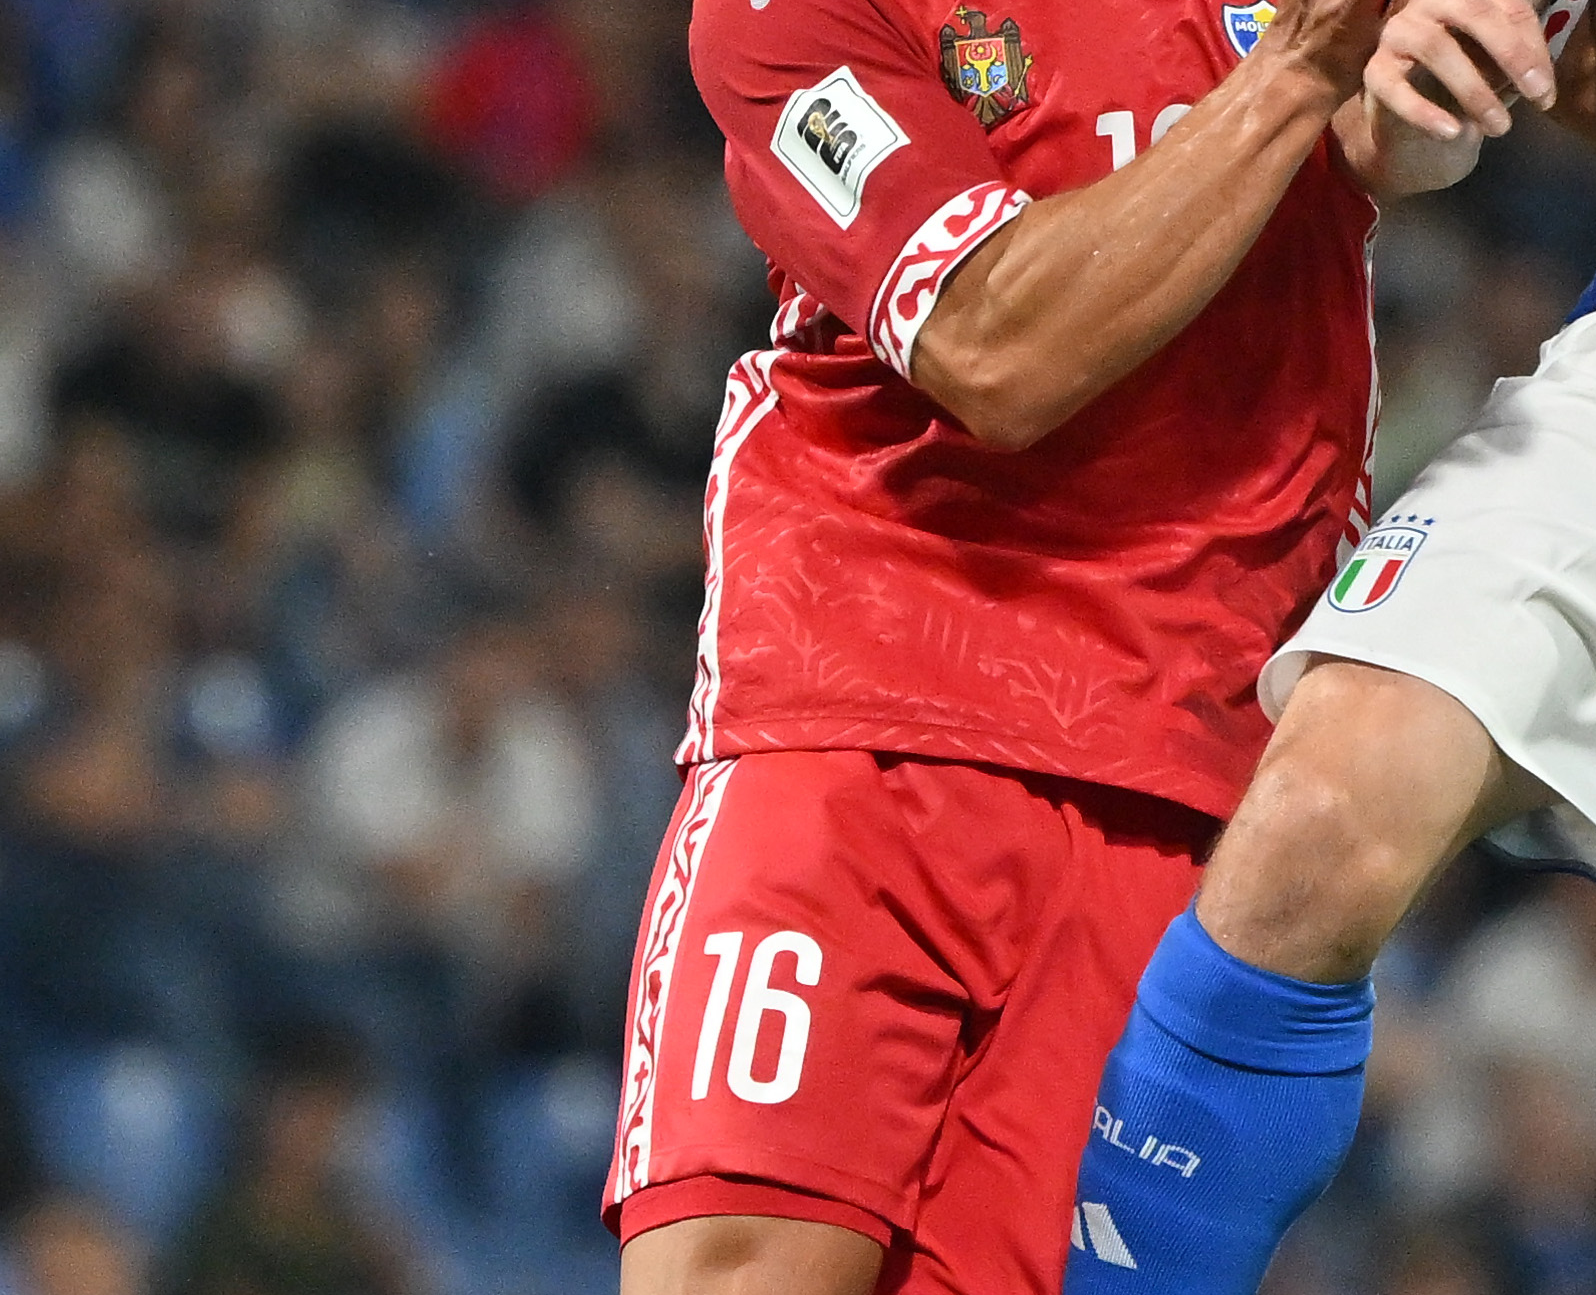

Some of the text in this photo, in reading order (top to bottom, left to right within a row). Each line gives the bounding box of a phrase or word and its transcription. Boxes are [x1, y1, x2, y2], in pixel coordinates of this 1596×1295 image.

[1096, 104, 1193, 172] 1
[1359, 535, 1415, 552] ITALIA
[691, 930, 823, 1104] 16
[1092, 1097, 1201, 1178] ALIA
